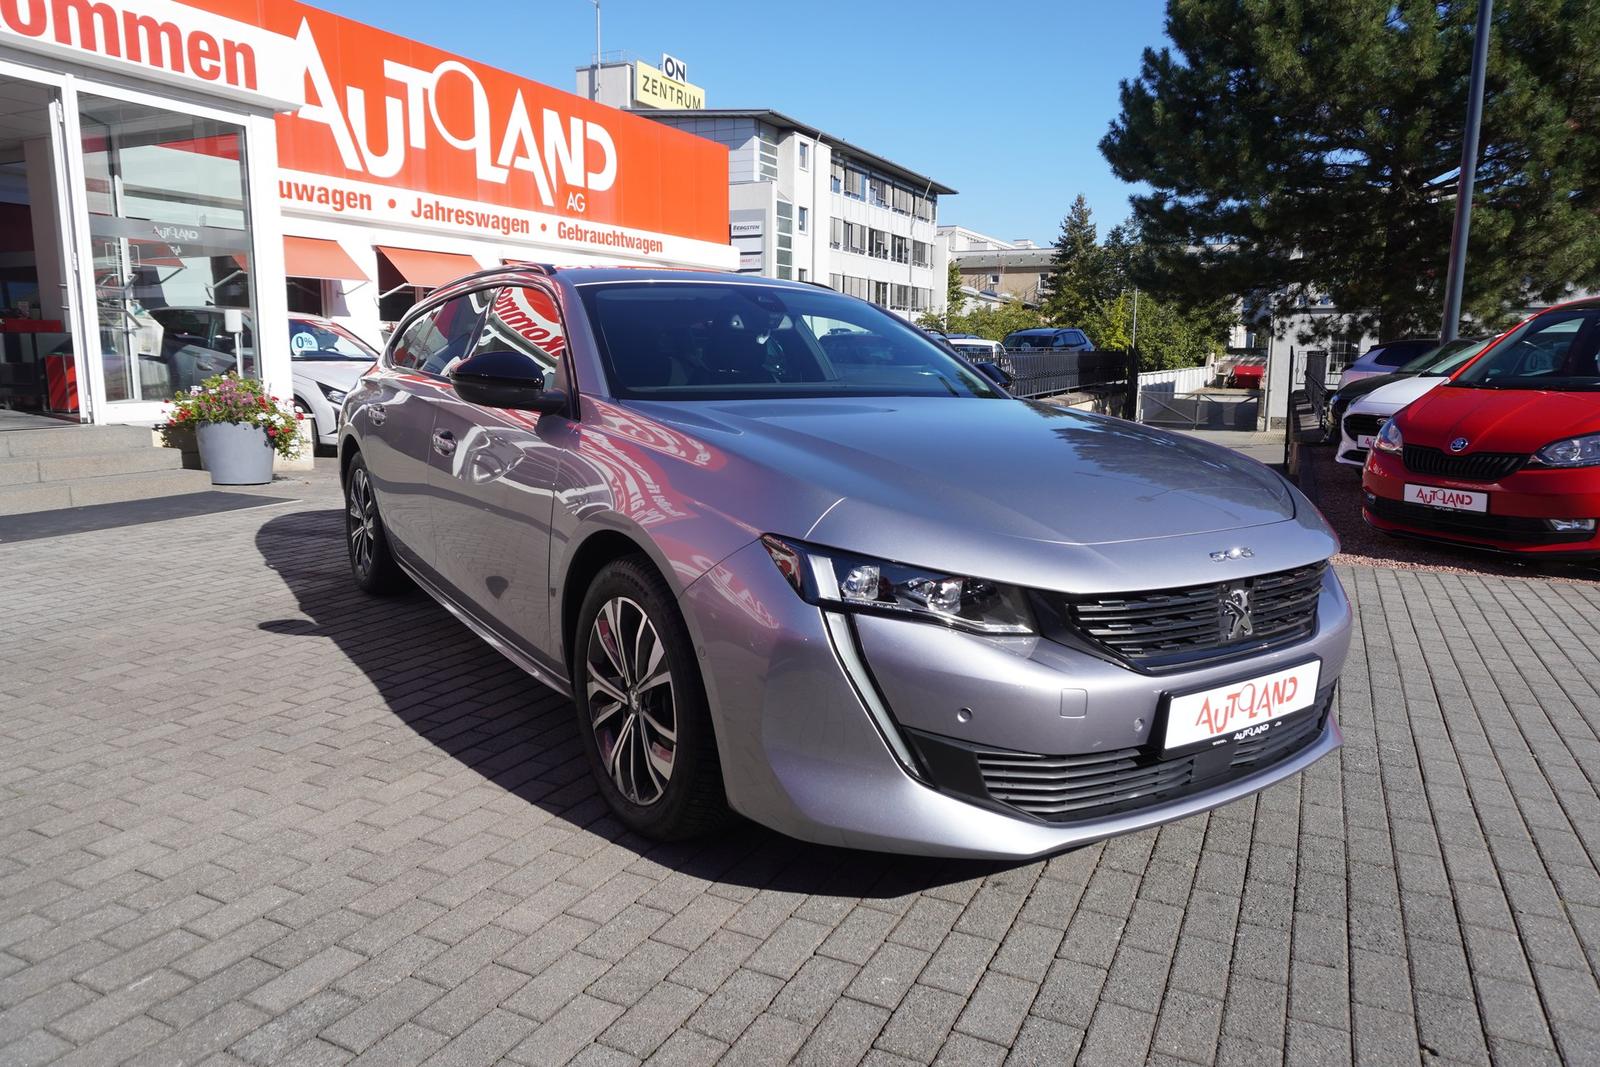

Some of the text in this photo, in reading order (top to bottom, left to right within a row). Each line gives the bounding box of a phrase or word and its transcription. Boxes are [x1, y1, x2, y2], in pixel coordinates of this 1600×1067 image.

[664, 57, 686, 83] ON
[642, 74, 701, 109] ZENTRUM
[280, 16, 617, 207] AUTOLAND
[566, 192, 586, 213] AG
[411, 198, 530, 236] Jahreswagen
[557, 221, 663, 255] Gebrauchtwagen
[1416, 487, 1473, 507] AUTOLAND
[1195, 676, 1298, 734] AUTOLAND
[1233, 723, 1269, 740] AUTOLAND
